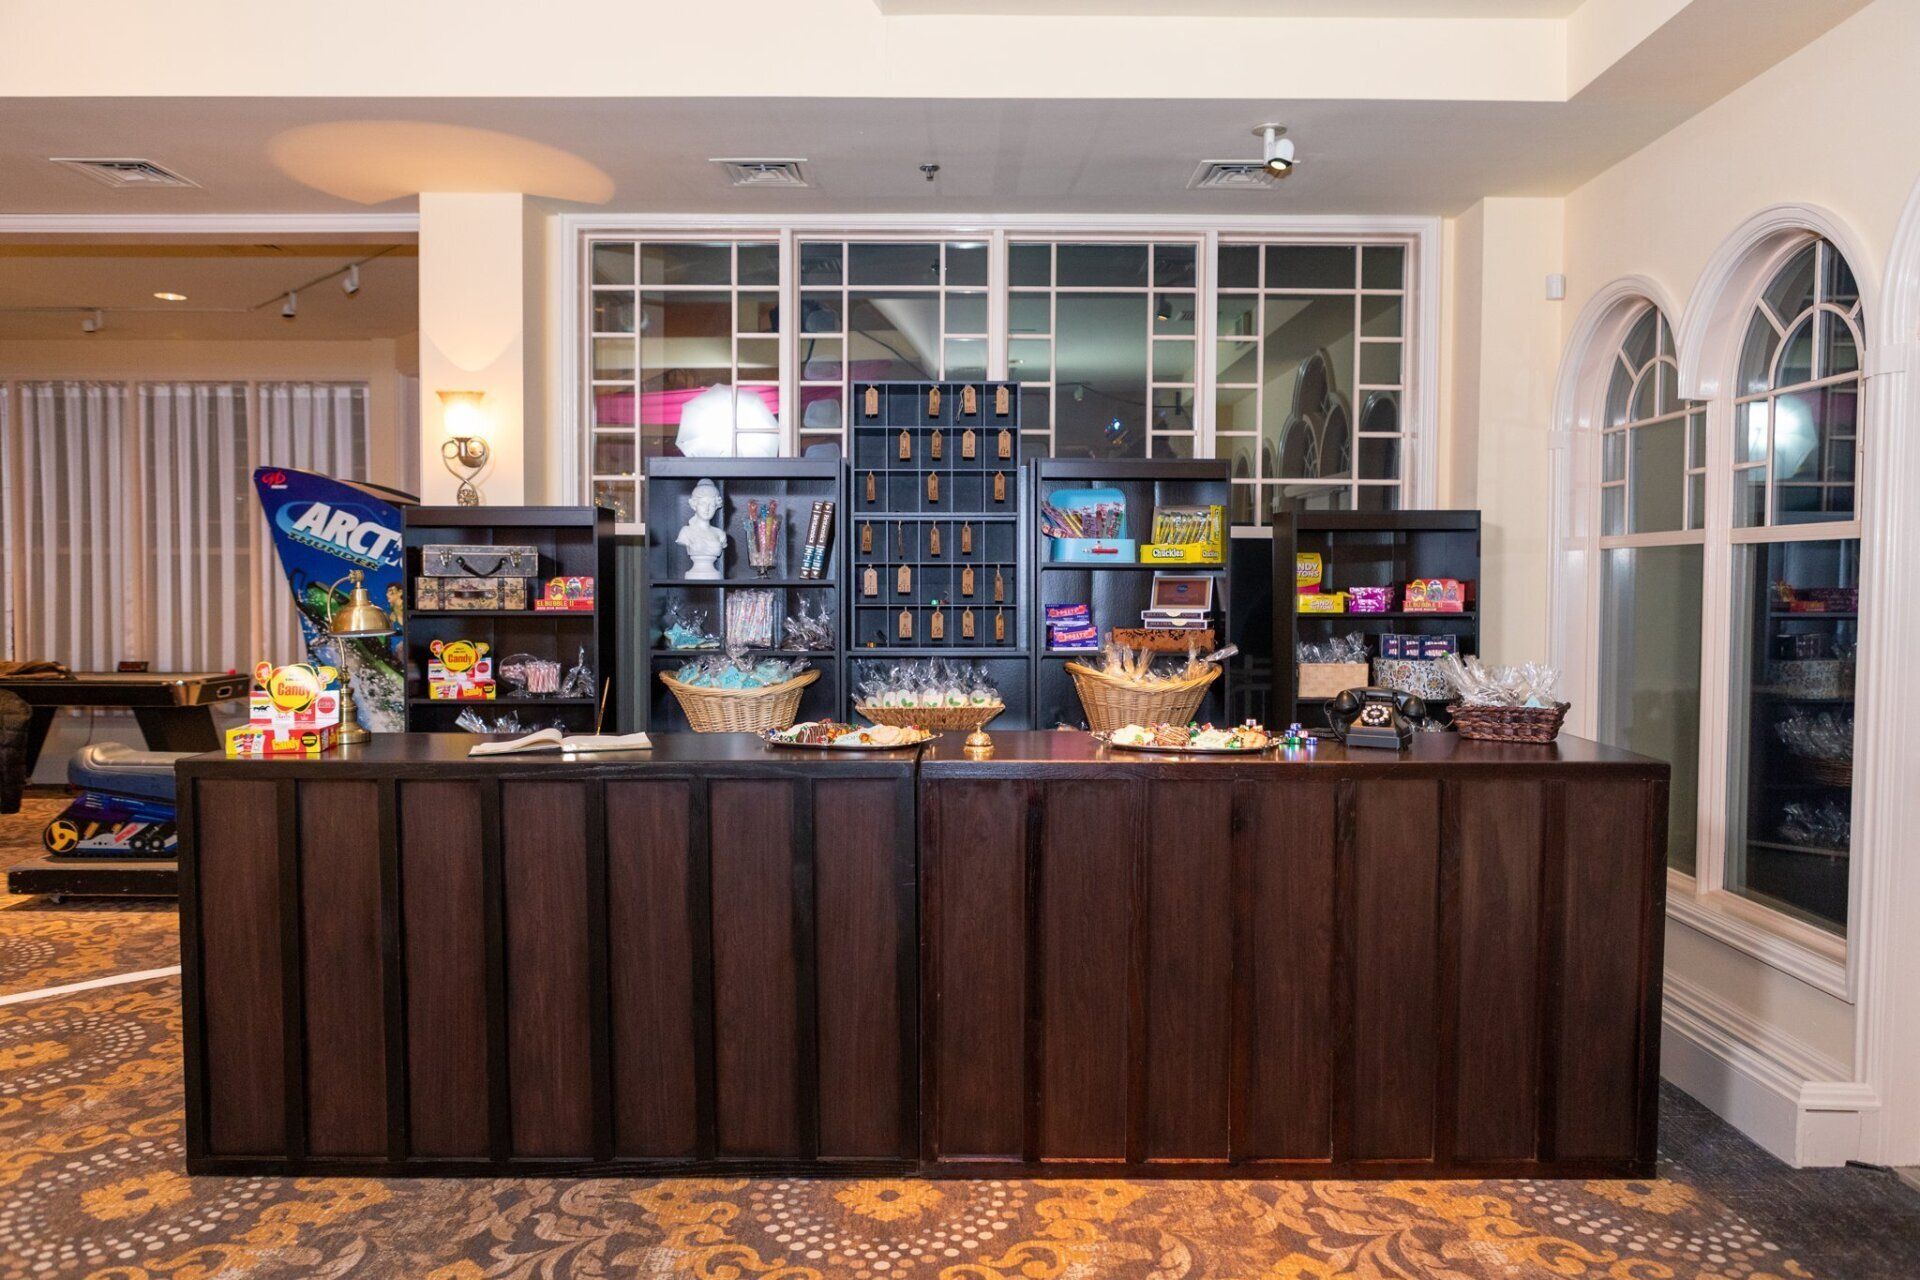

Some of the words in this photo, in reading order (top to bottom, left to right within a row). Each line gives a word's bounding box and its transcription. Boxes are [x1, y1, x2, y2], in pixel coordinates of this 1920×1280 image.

[288, 531, 379, 571] THUNDER
[1152, 549, 1184, 559] Chuckles
[1297, 563, 1319, 571] NDY
[1297, 570, 1319, 578] TONS
[447, 653, 472, 665] Candy
[277, 682, 311, 698] Candy
[272, 737, 300, 751] Candy
